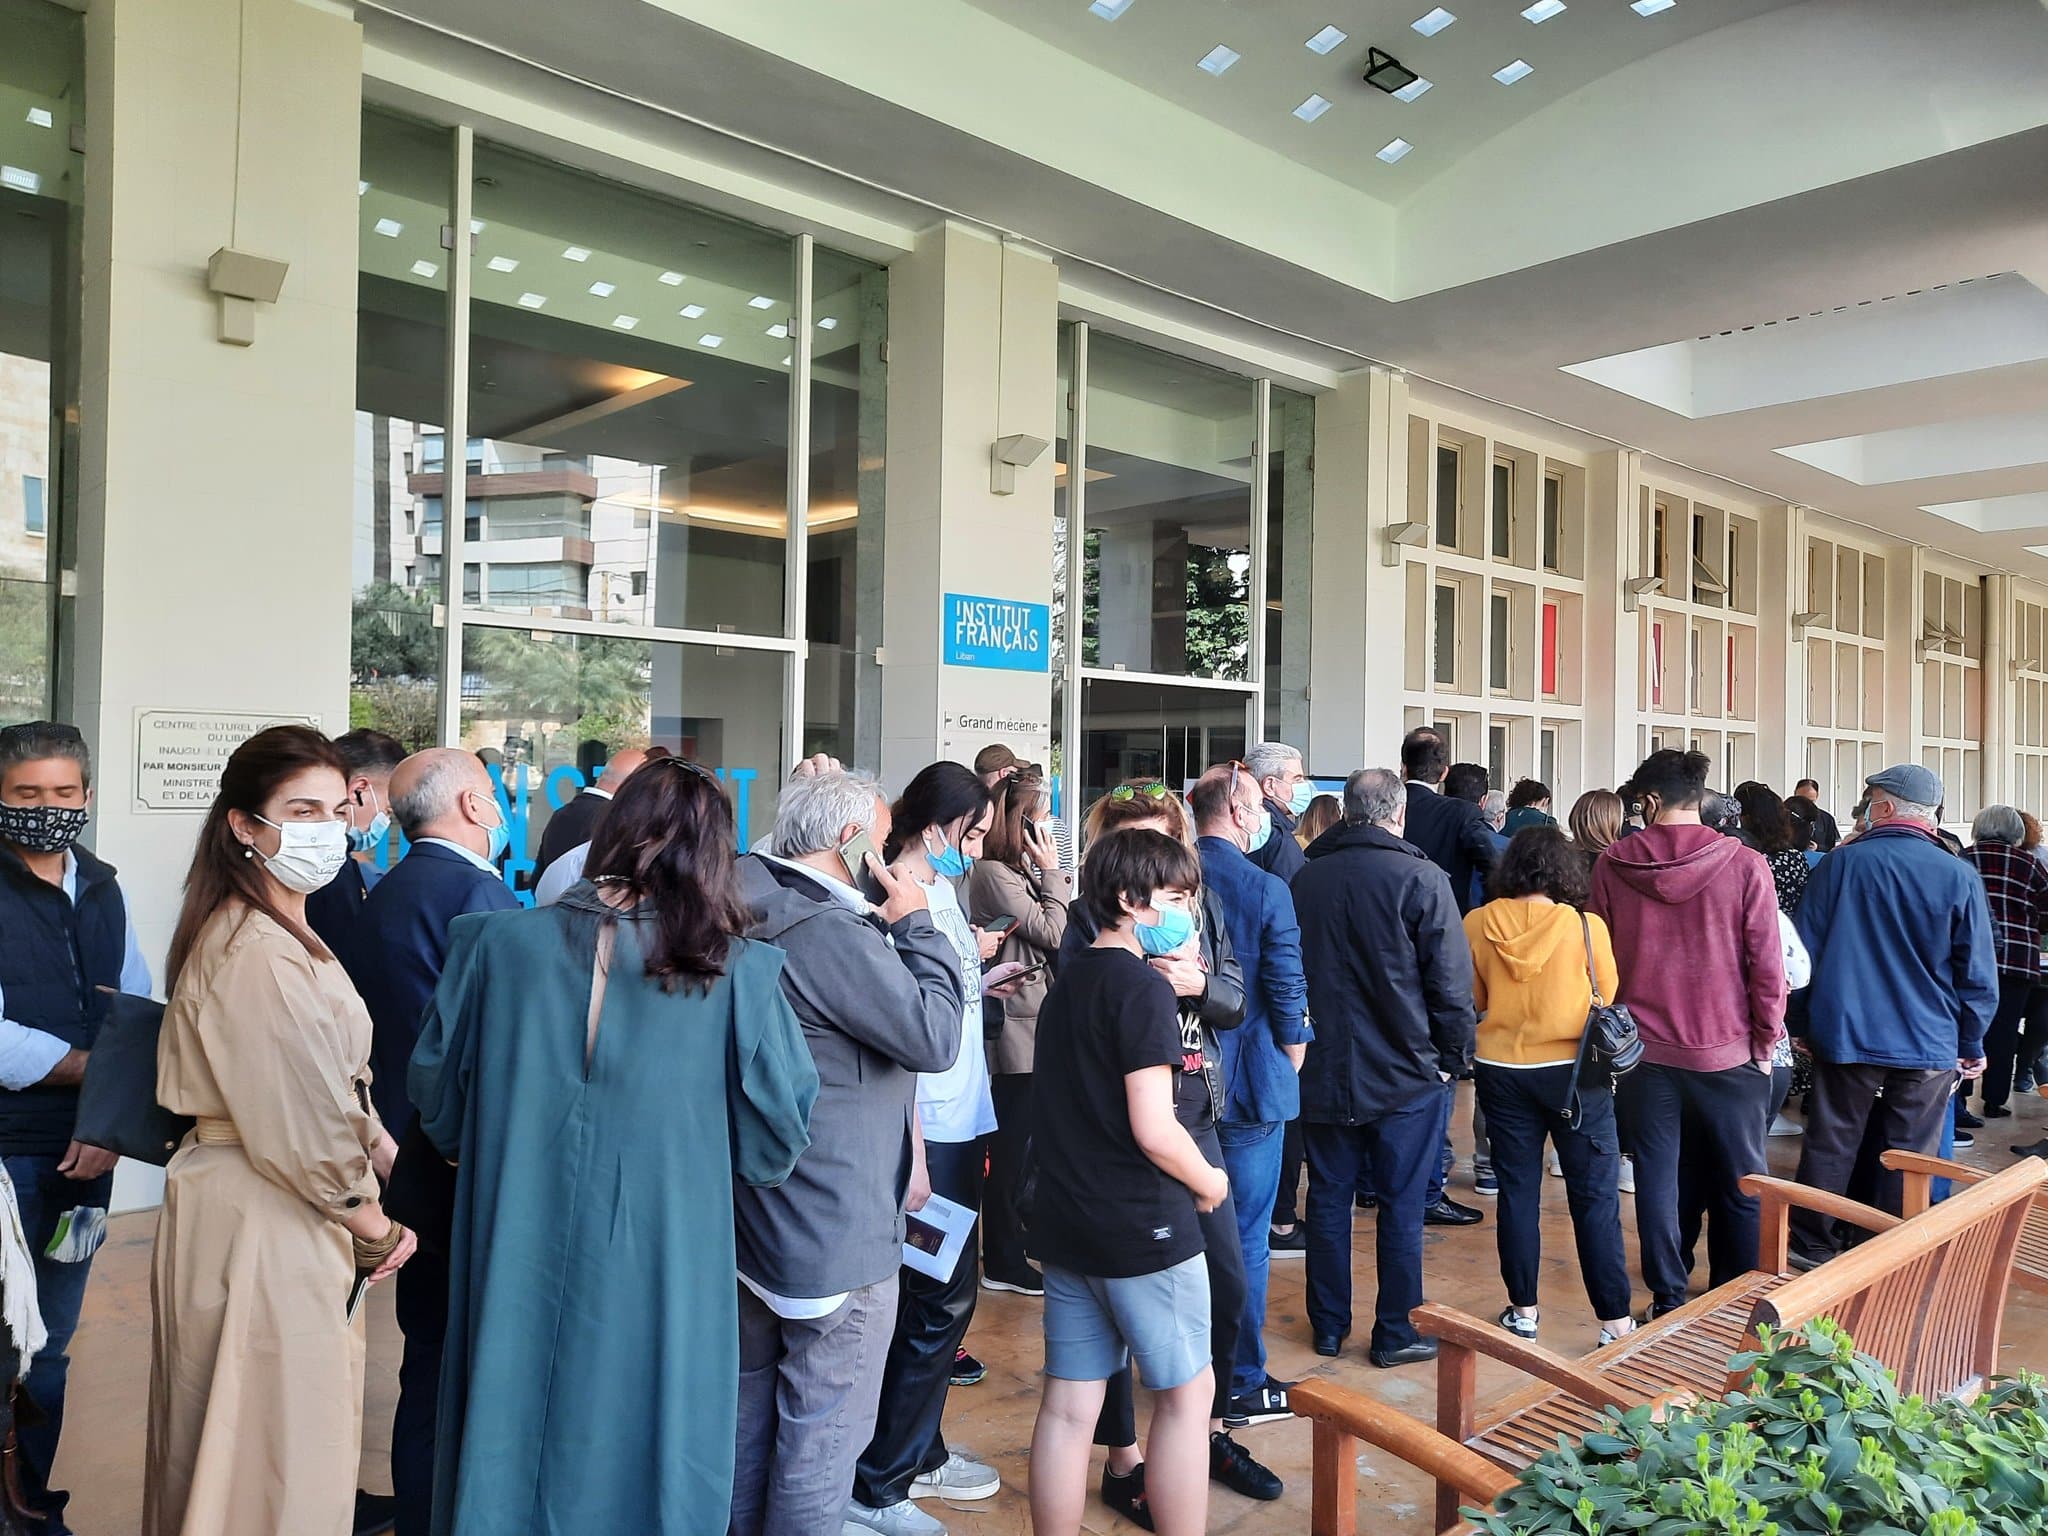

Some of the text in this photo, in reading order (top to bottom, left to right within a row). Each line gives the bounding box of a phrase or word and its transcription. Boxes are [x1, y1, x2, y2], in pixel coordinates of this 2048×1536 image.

[956, 600, 1031, 631] INSTITUT
[956, 621, 1039, 653] FRANÇAIS
[955, 651, 976, 661] Liban
[153, 720, 196, 730] CENTRE
[959, 714, 1039, 732] Grand mécène
[208, 733, 223, 742] DU
[143, 762, 222, 771] PAR MONSIEUR
[163, 779, 213, 788] MINISTRE
[162, 791, 175, 800] ET
[179, 791, 194, 800] DE
[197, 792, 210, 800] LA
